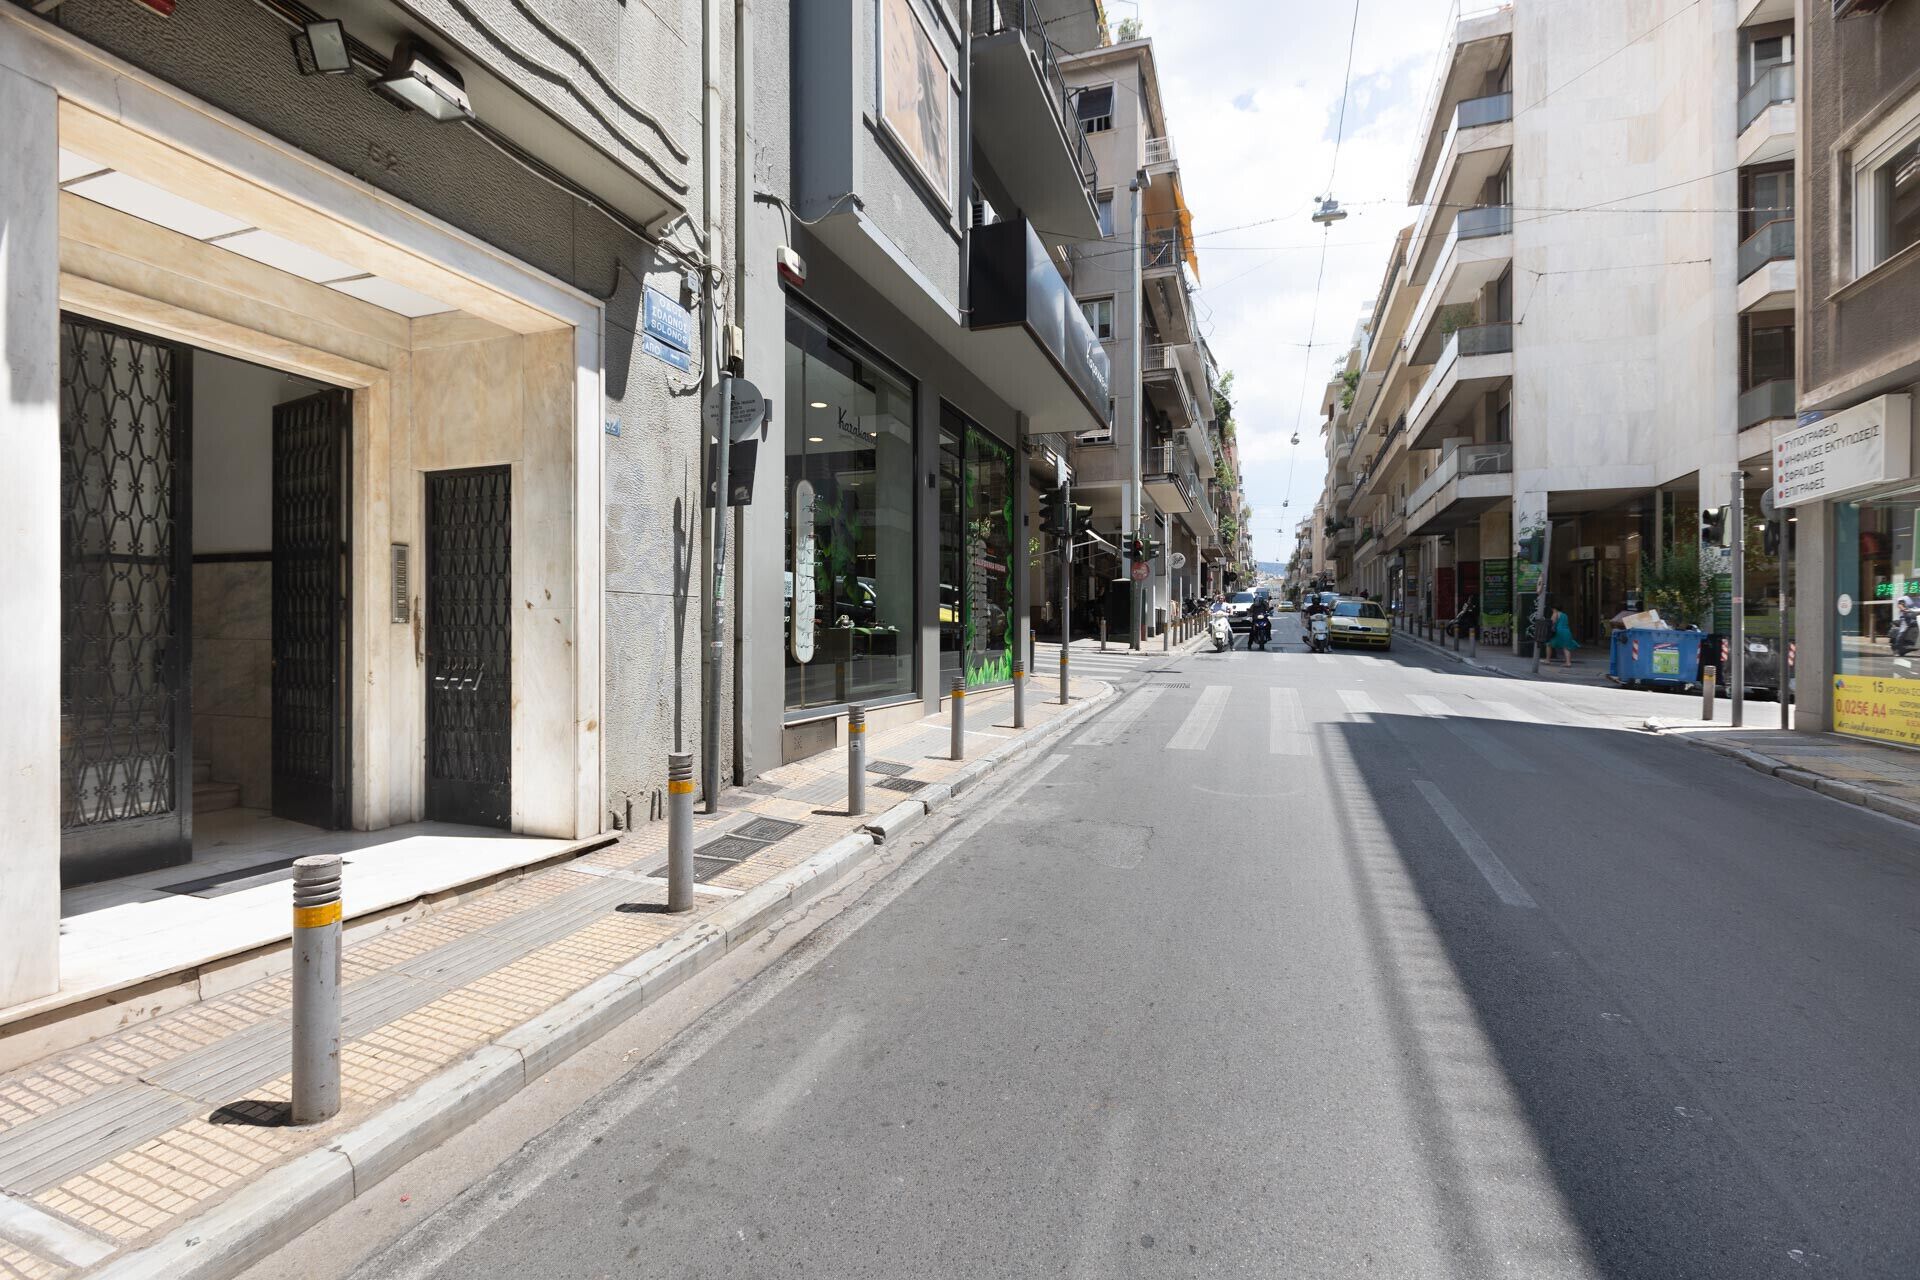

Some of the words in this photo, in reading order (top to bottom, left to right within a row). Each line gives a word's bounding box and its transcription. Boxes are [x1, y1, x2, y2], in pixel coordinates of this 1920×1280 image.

[652, 305, 688, 334] ΣΟΛΩΝΟΣ
[651, 319, 687, 345] SOLONOS
[644, 341, 661, 356] ΑΠΟ
[1785, 422, 1839, 450] ΤΥΠΟΓΡΑΦΕΙΟ
[1785, 444, 1823, 467] ΨΗΦΙΑΚΕΣ
[1825, 425, 1880, 453] ΕΚΤΥΠΩΣΕΙΣ
[1784, 461, 1825, 483] ΣΦΡΑΓΙΔΕΣ
[1785, 477, 1825, 498] ΕΠΙΓΡΑΦΕΣ
[1872, 681, 1884, 694] 15
[1872, 702, 1887, 720] A4
